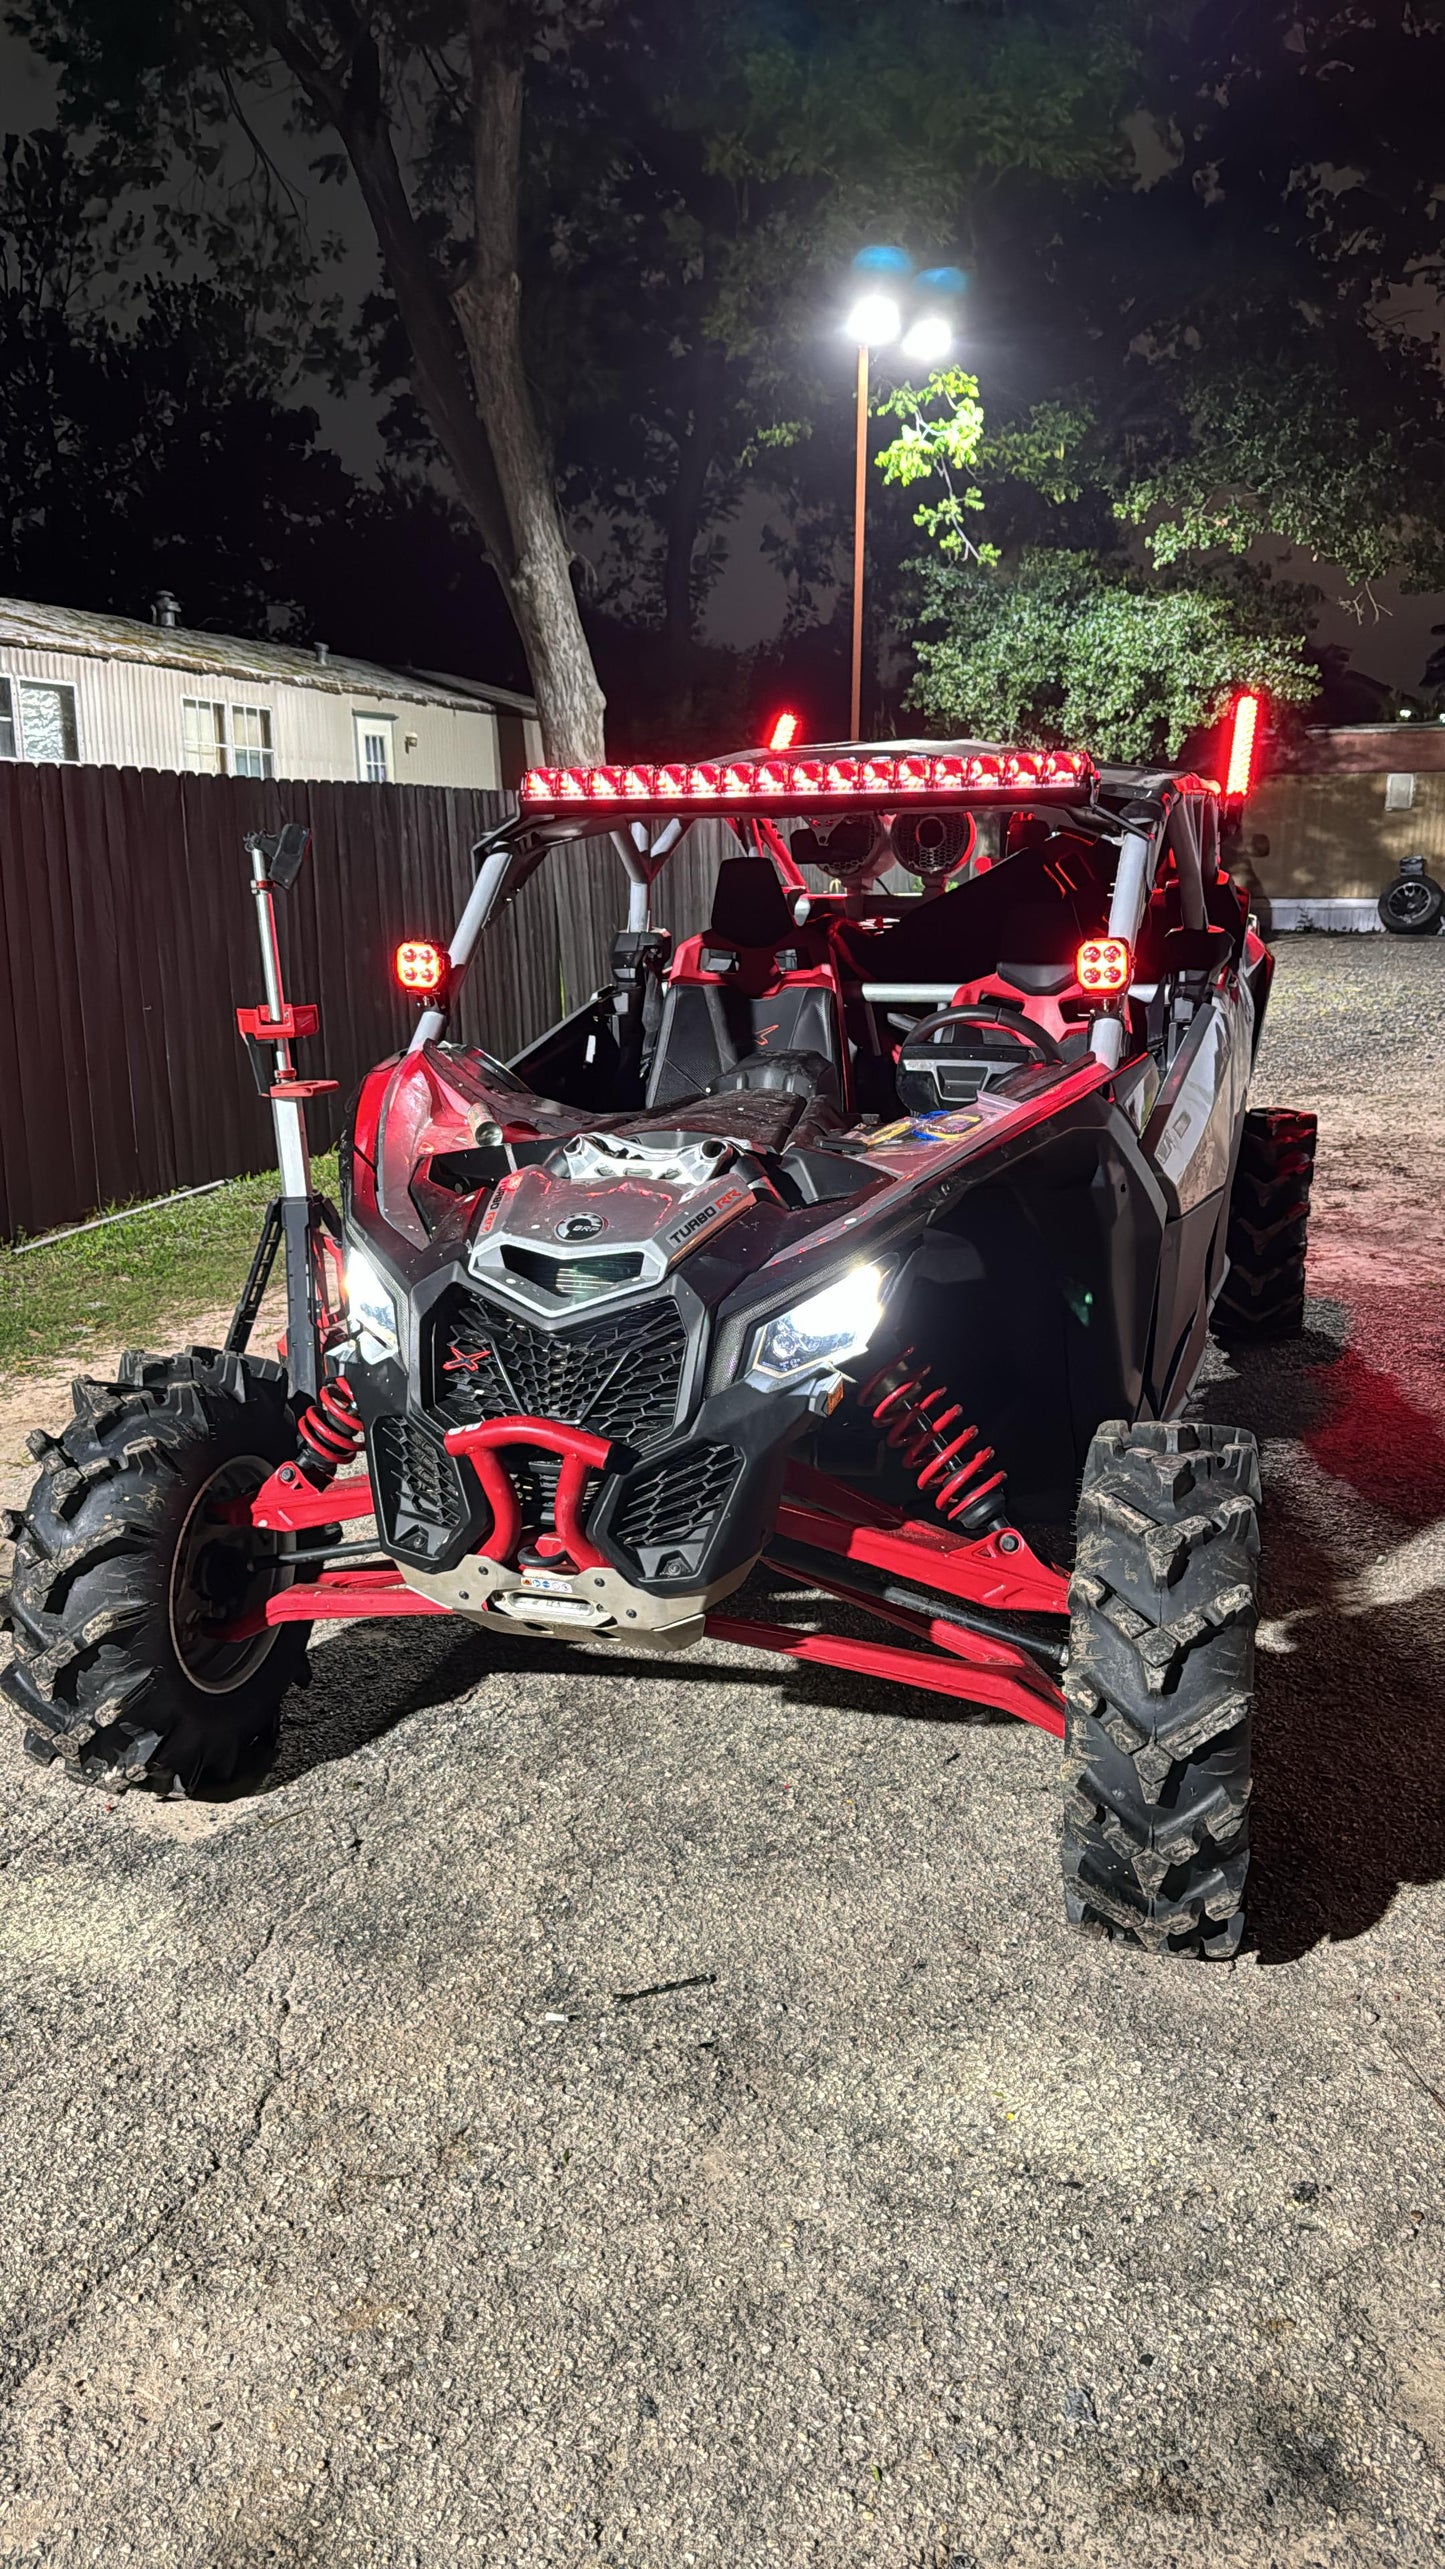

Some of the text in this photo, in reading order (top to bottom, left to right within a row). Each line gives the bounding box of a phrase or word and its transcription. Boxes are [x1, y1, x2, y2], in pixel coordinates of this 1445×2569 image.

[572, 1224, 600, 1232] BRP
[669, 1188, 743, 1244] TURBO RR
